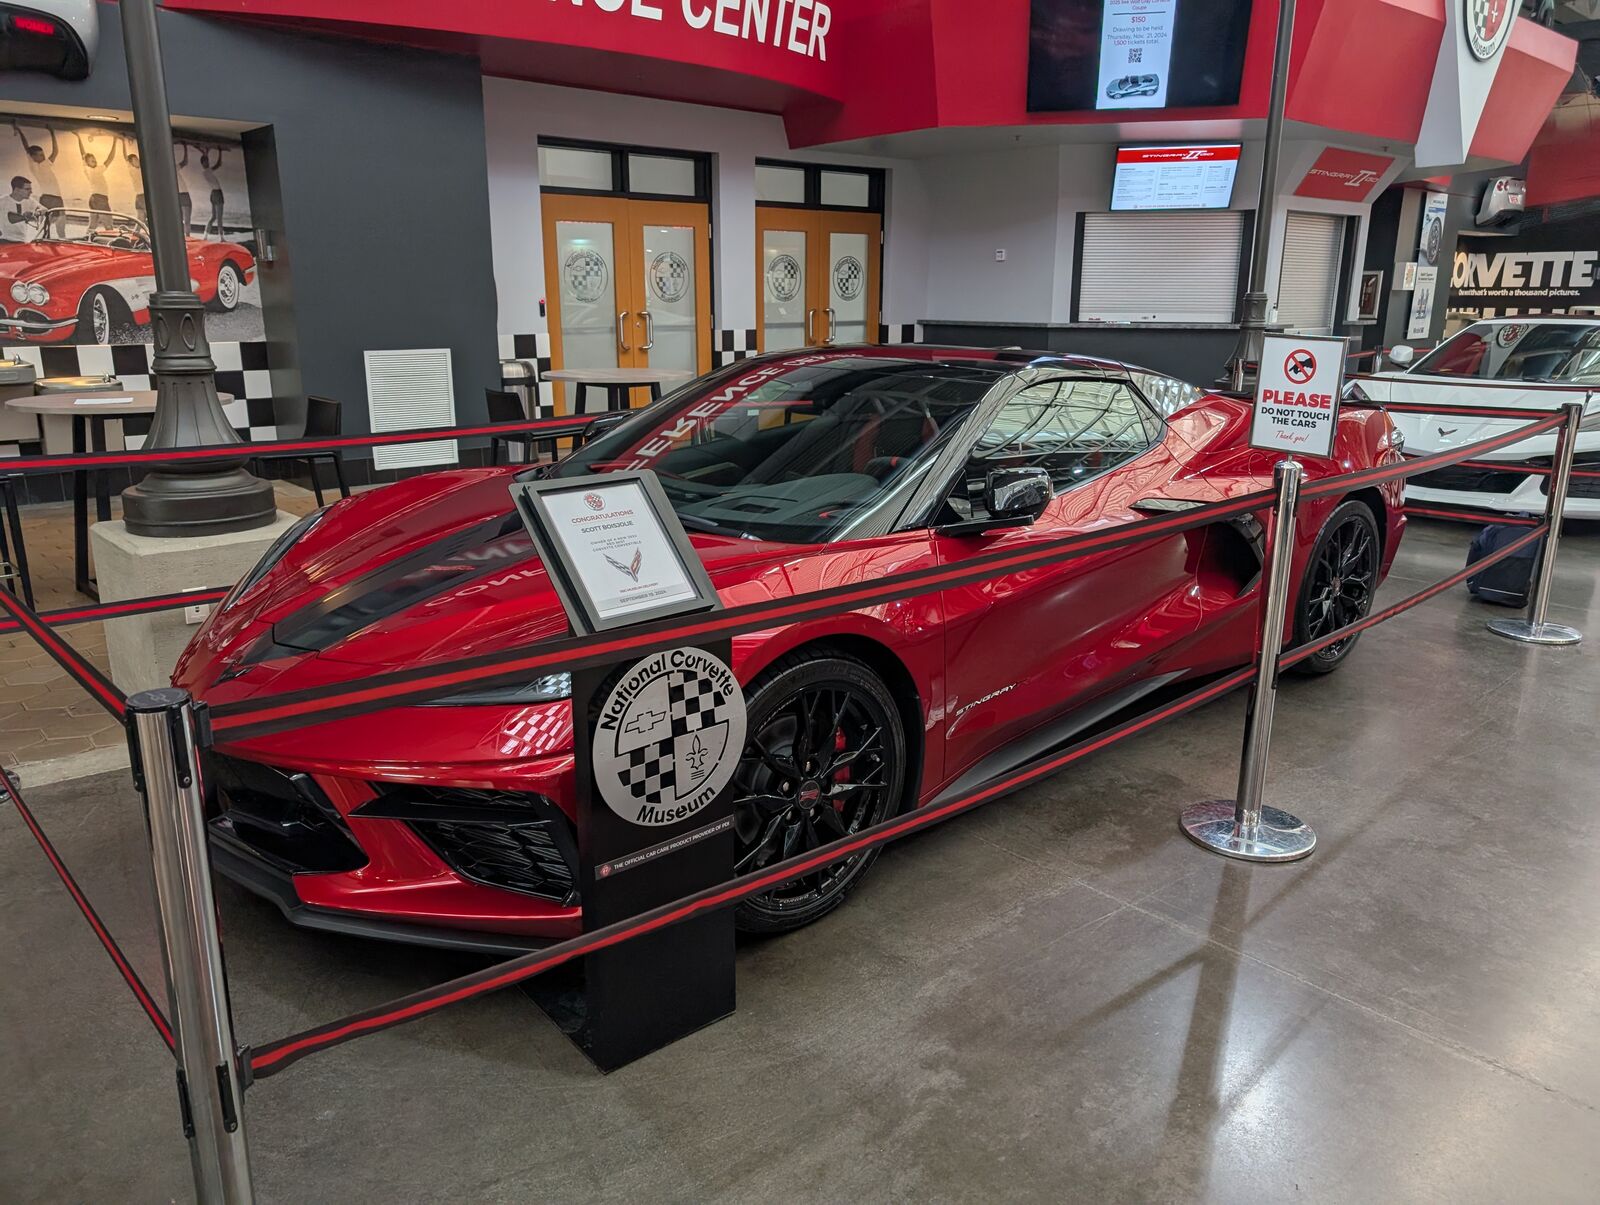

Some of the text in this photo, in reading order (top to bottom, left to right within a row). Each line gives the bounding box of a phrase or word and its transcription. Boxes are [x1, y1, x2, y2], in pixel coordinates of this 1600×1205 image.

[1472, 32, 1496, 56] Museum
[1308, 169, 1354, 179] STINGRAY
[1548, 289, 1580, 297] pictures.
[1262, 389, 1332, 409] PLEASE
[1298, 411, 1330, 420] TOUCH
[1272, 417, 1317, 428] THE CARS
[1275, 430, 1293, 440] Thank
[571, 510, 634, 524] CONGRATULATIONS
[615, 540, 641, 549] CONVERTIBLE
[620, 594, 648, 603] SEPTEMBER
[600, 650, 734, 730] National Corvette
[956, 683, 1016, 716] STINGRAY
[636, 786, 716, 823] Museum
[624, 855, 645, 866] OFFICIAL
[657, 846, 670, 854] CARE
[670, 836, 692, 850] PRODUCT
[692, 828, 715, 840] PROVIDER
